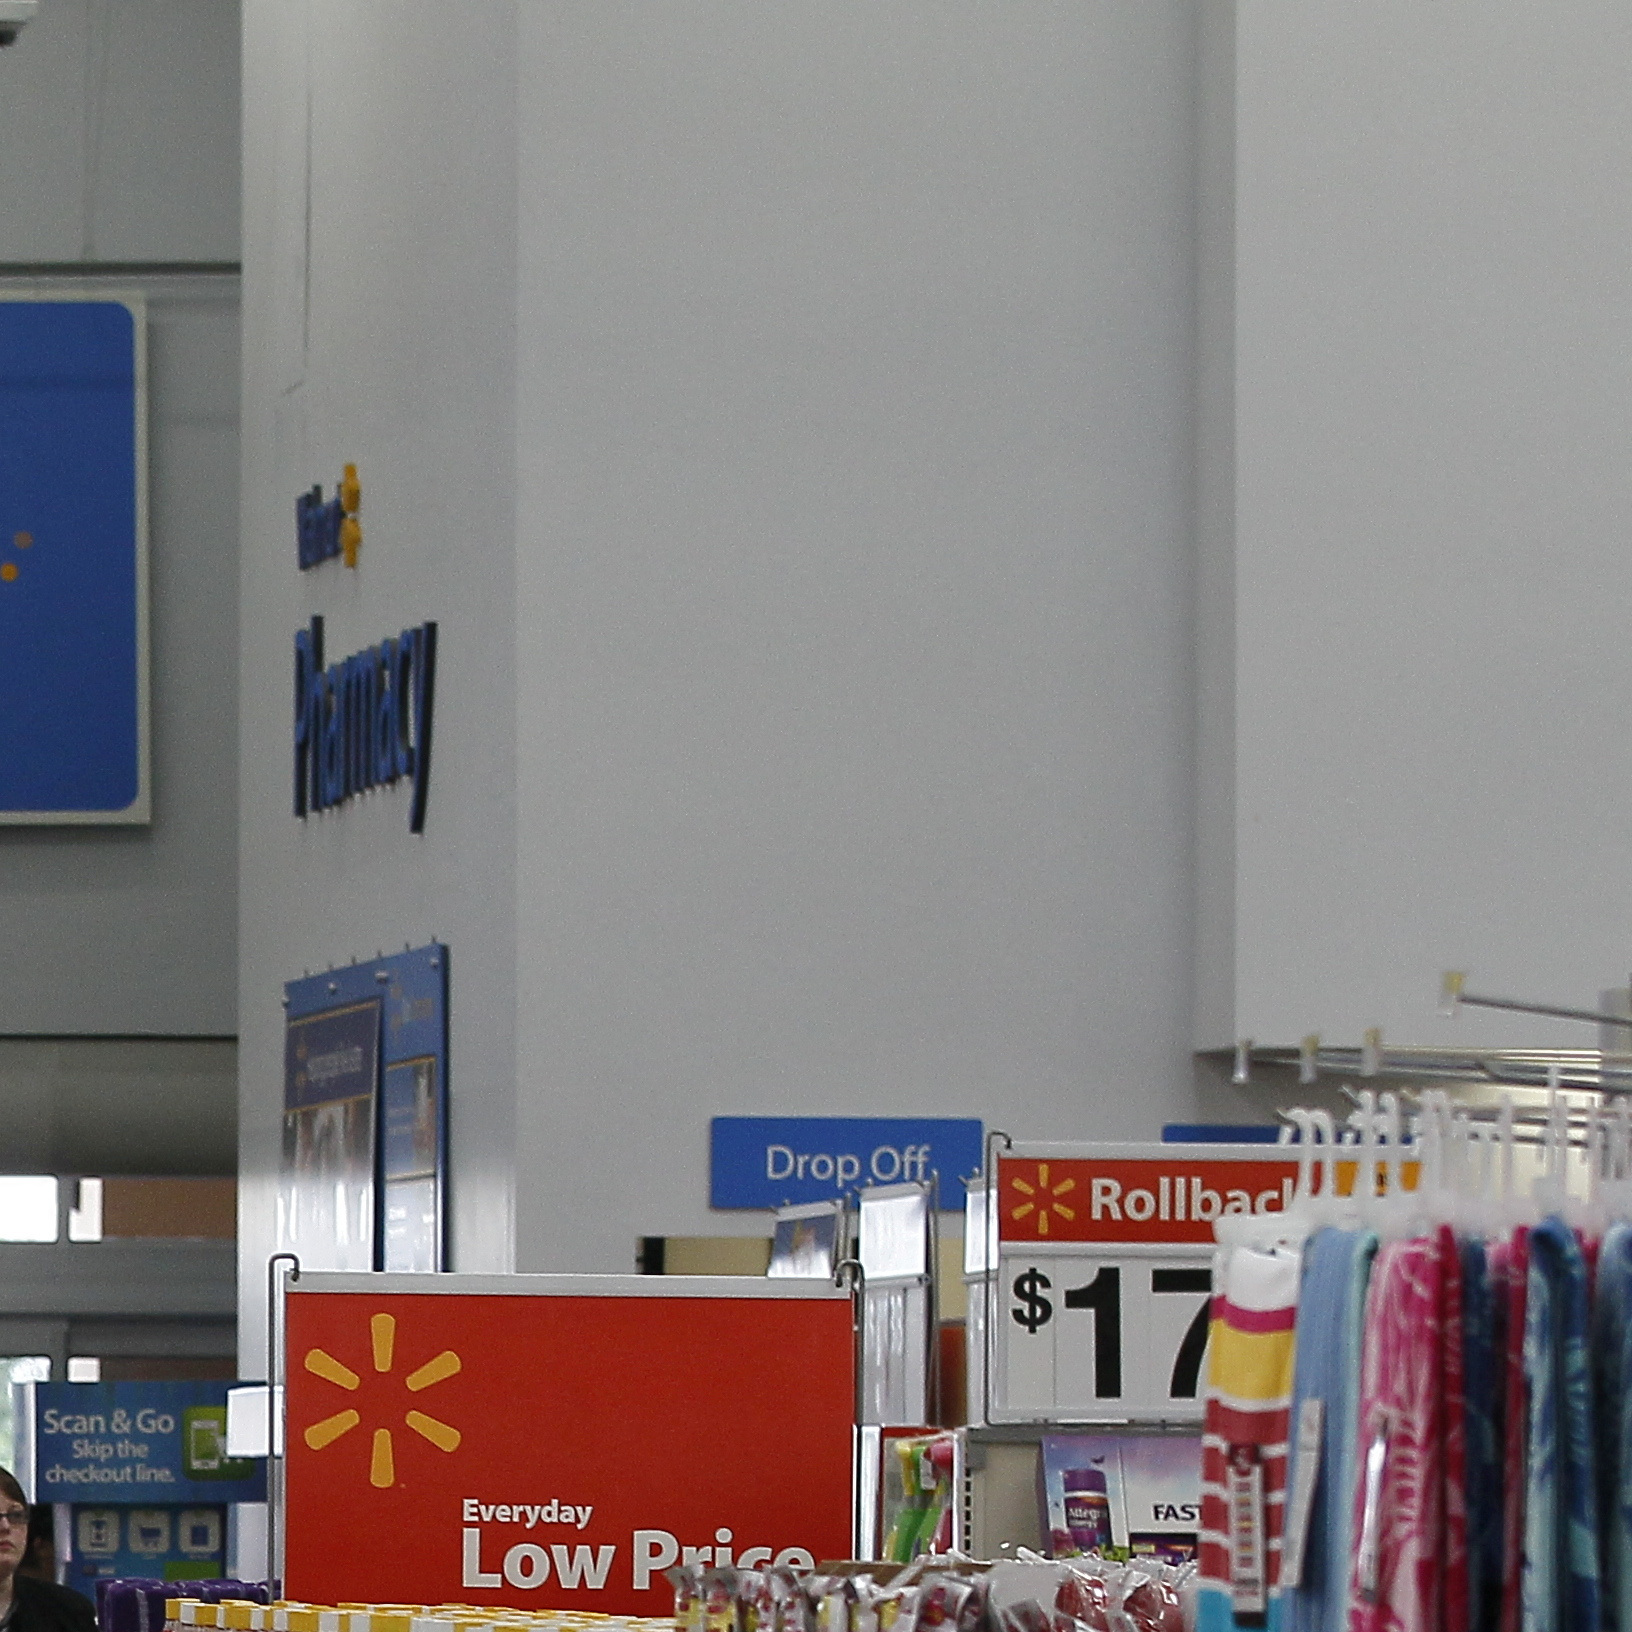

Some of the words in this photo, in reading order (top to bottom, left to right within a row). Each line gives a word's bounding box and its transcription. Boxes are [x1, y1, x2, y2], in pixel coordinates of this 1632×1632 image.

[766, 1145, 861, 1184] Drop
[871, 1144, 931, 1182] Off
[43, 1408, 107, 1435] Scan
[110, 1408, 133, 1435] &
[137, 1408, 175, 1435] Go
[71, 1439, 114, 1462] Skip
[117, 1440, 150, 1460] the
[44, 1464, 132, 1484] checkout
[136, 1464, 176, 1484] line.
[461, 1498, 593, 1531] Everyday
[461, 1527, 617, 1590] Low
[633, 1527, 815, 1590] Price
